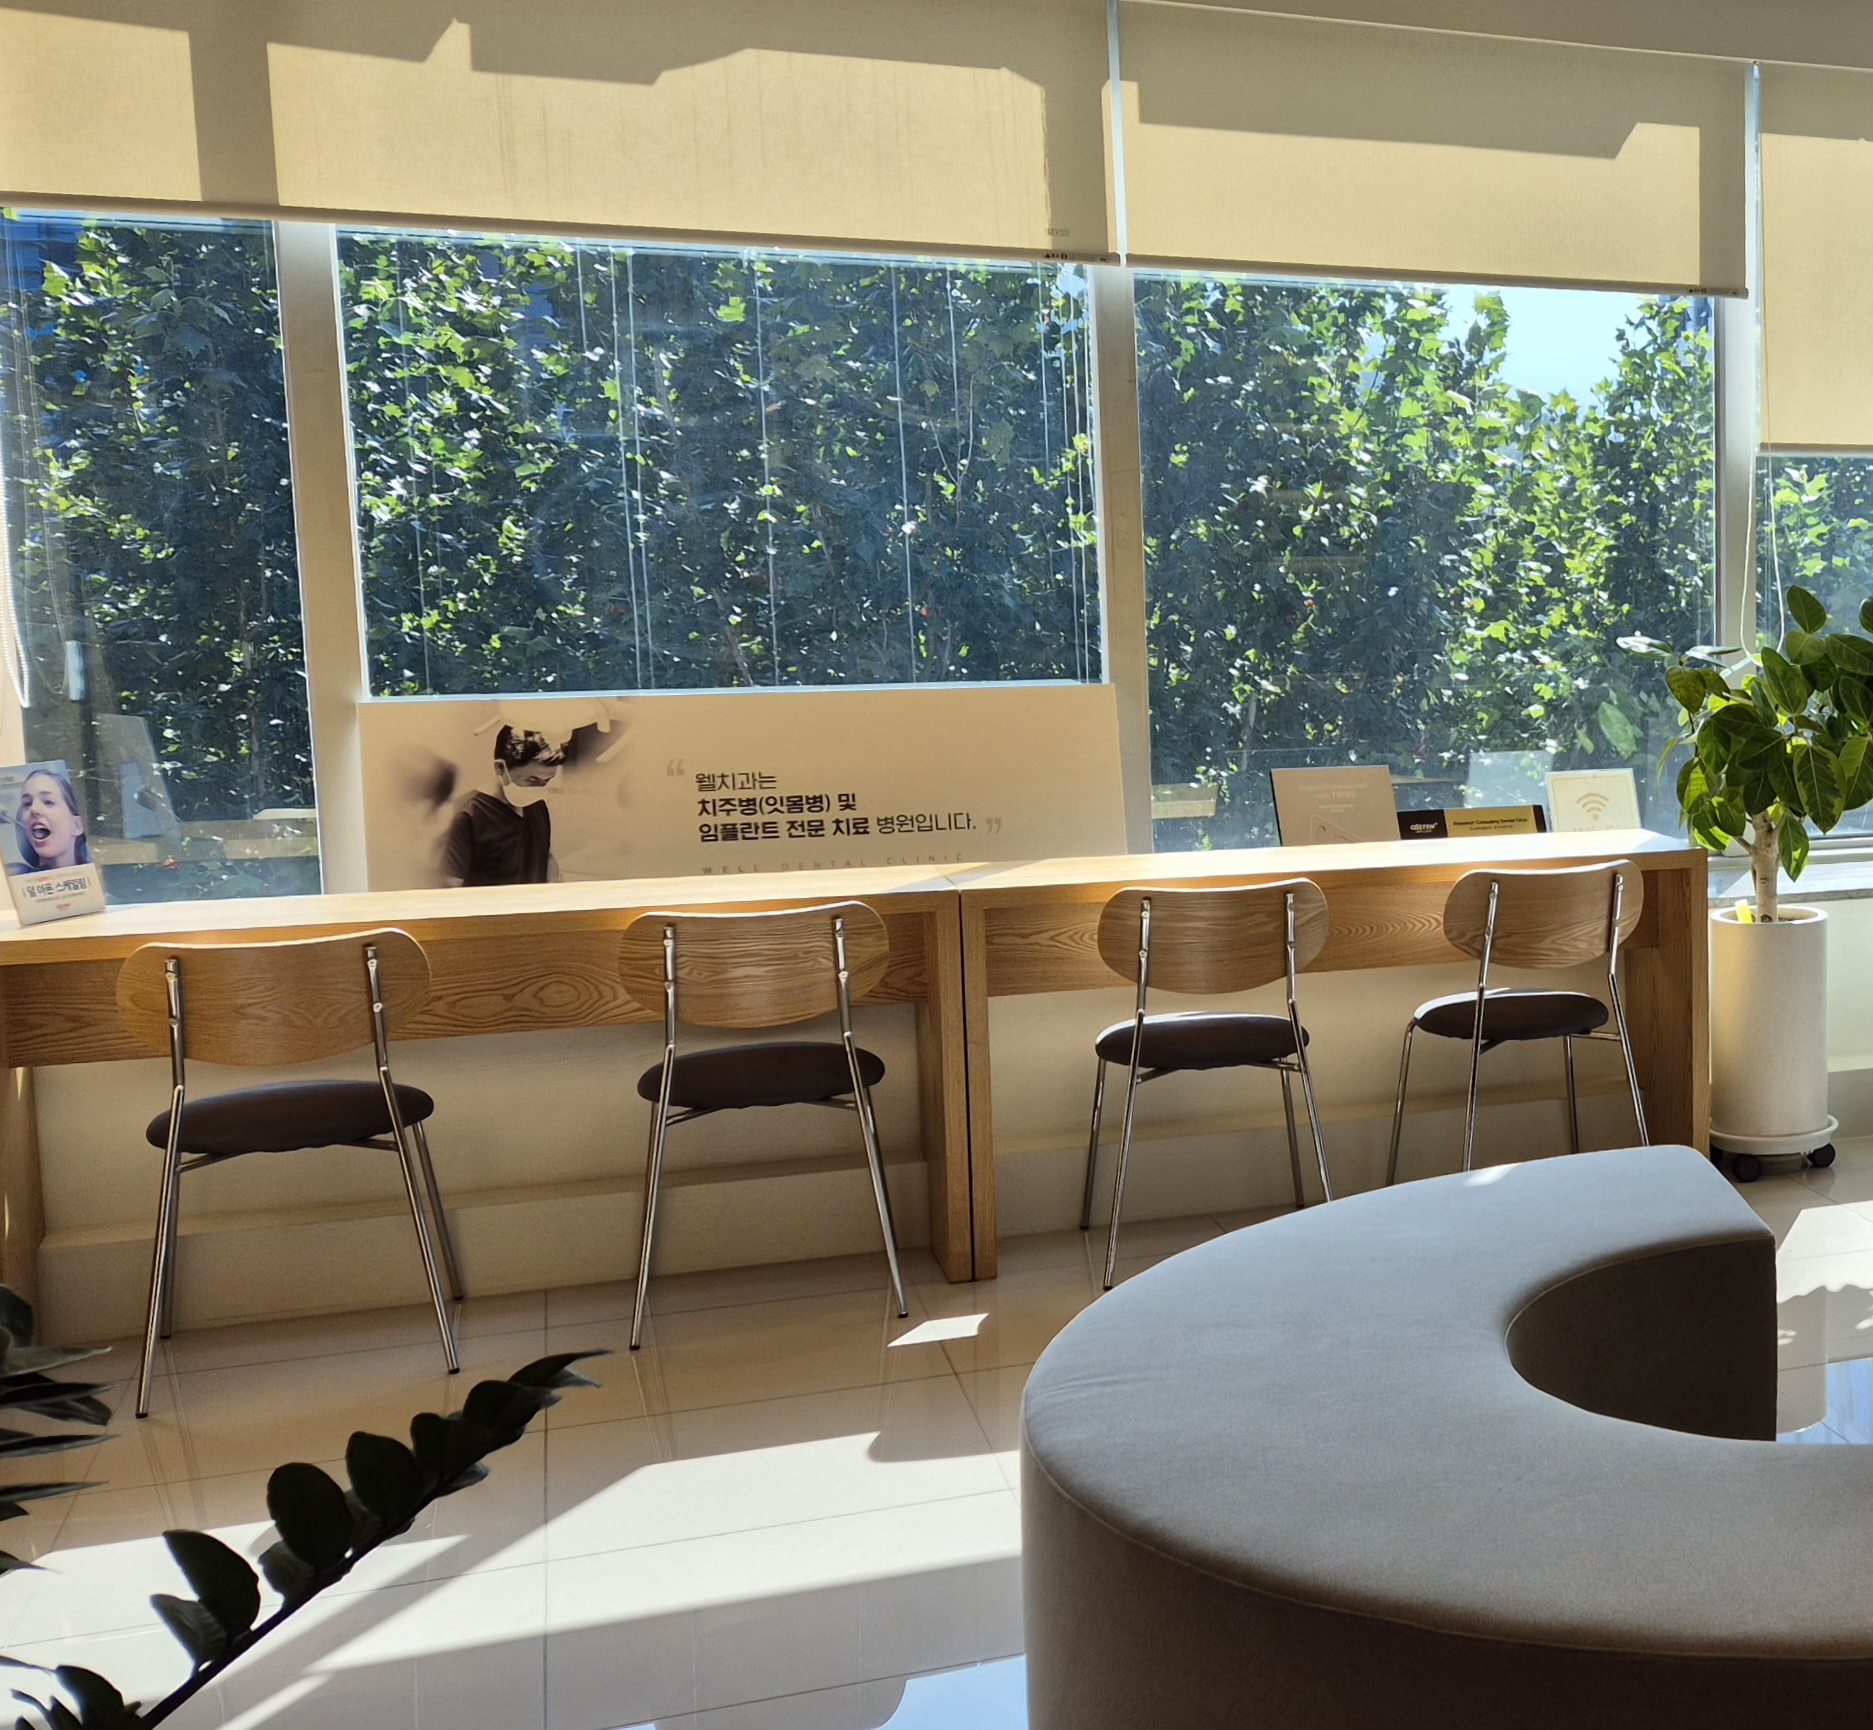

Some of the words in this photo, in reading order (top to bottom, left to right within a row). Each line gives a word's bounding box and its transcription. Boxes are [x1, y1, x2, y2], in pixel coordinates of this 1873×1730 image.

[695, 771, 778, 792] 웰치과는
[697, 793, 831, 817] 치주병(잇몸병)
[838, 793, 857, 811] 및
[698, 820, 780, 843] 임플란트
[786, 818, 826, 838] 전문
[831, 816, 871, 836] 치료
[876, 812, 977, 835] 병원입니다.
[702, 864, 760, 875] WELL
[781, 859, 866, 872] DENTAL
[886, 853, 962, 865] CLINIC
